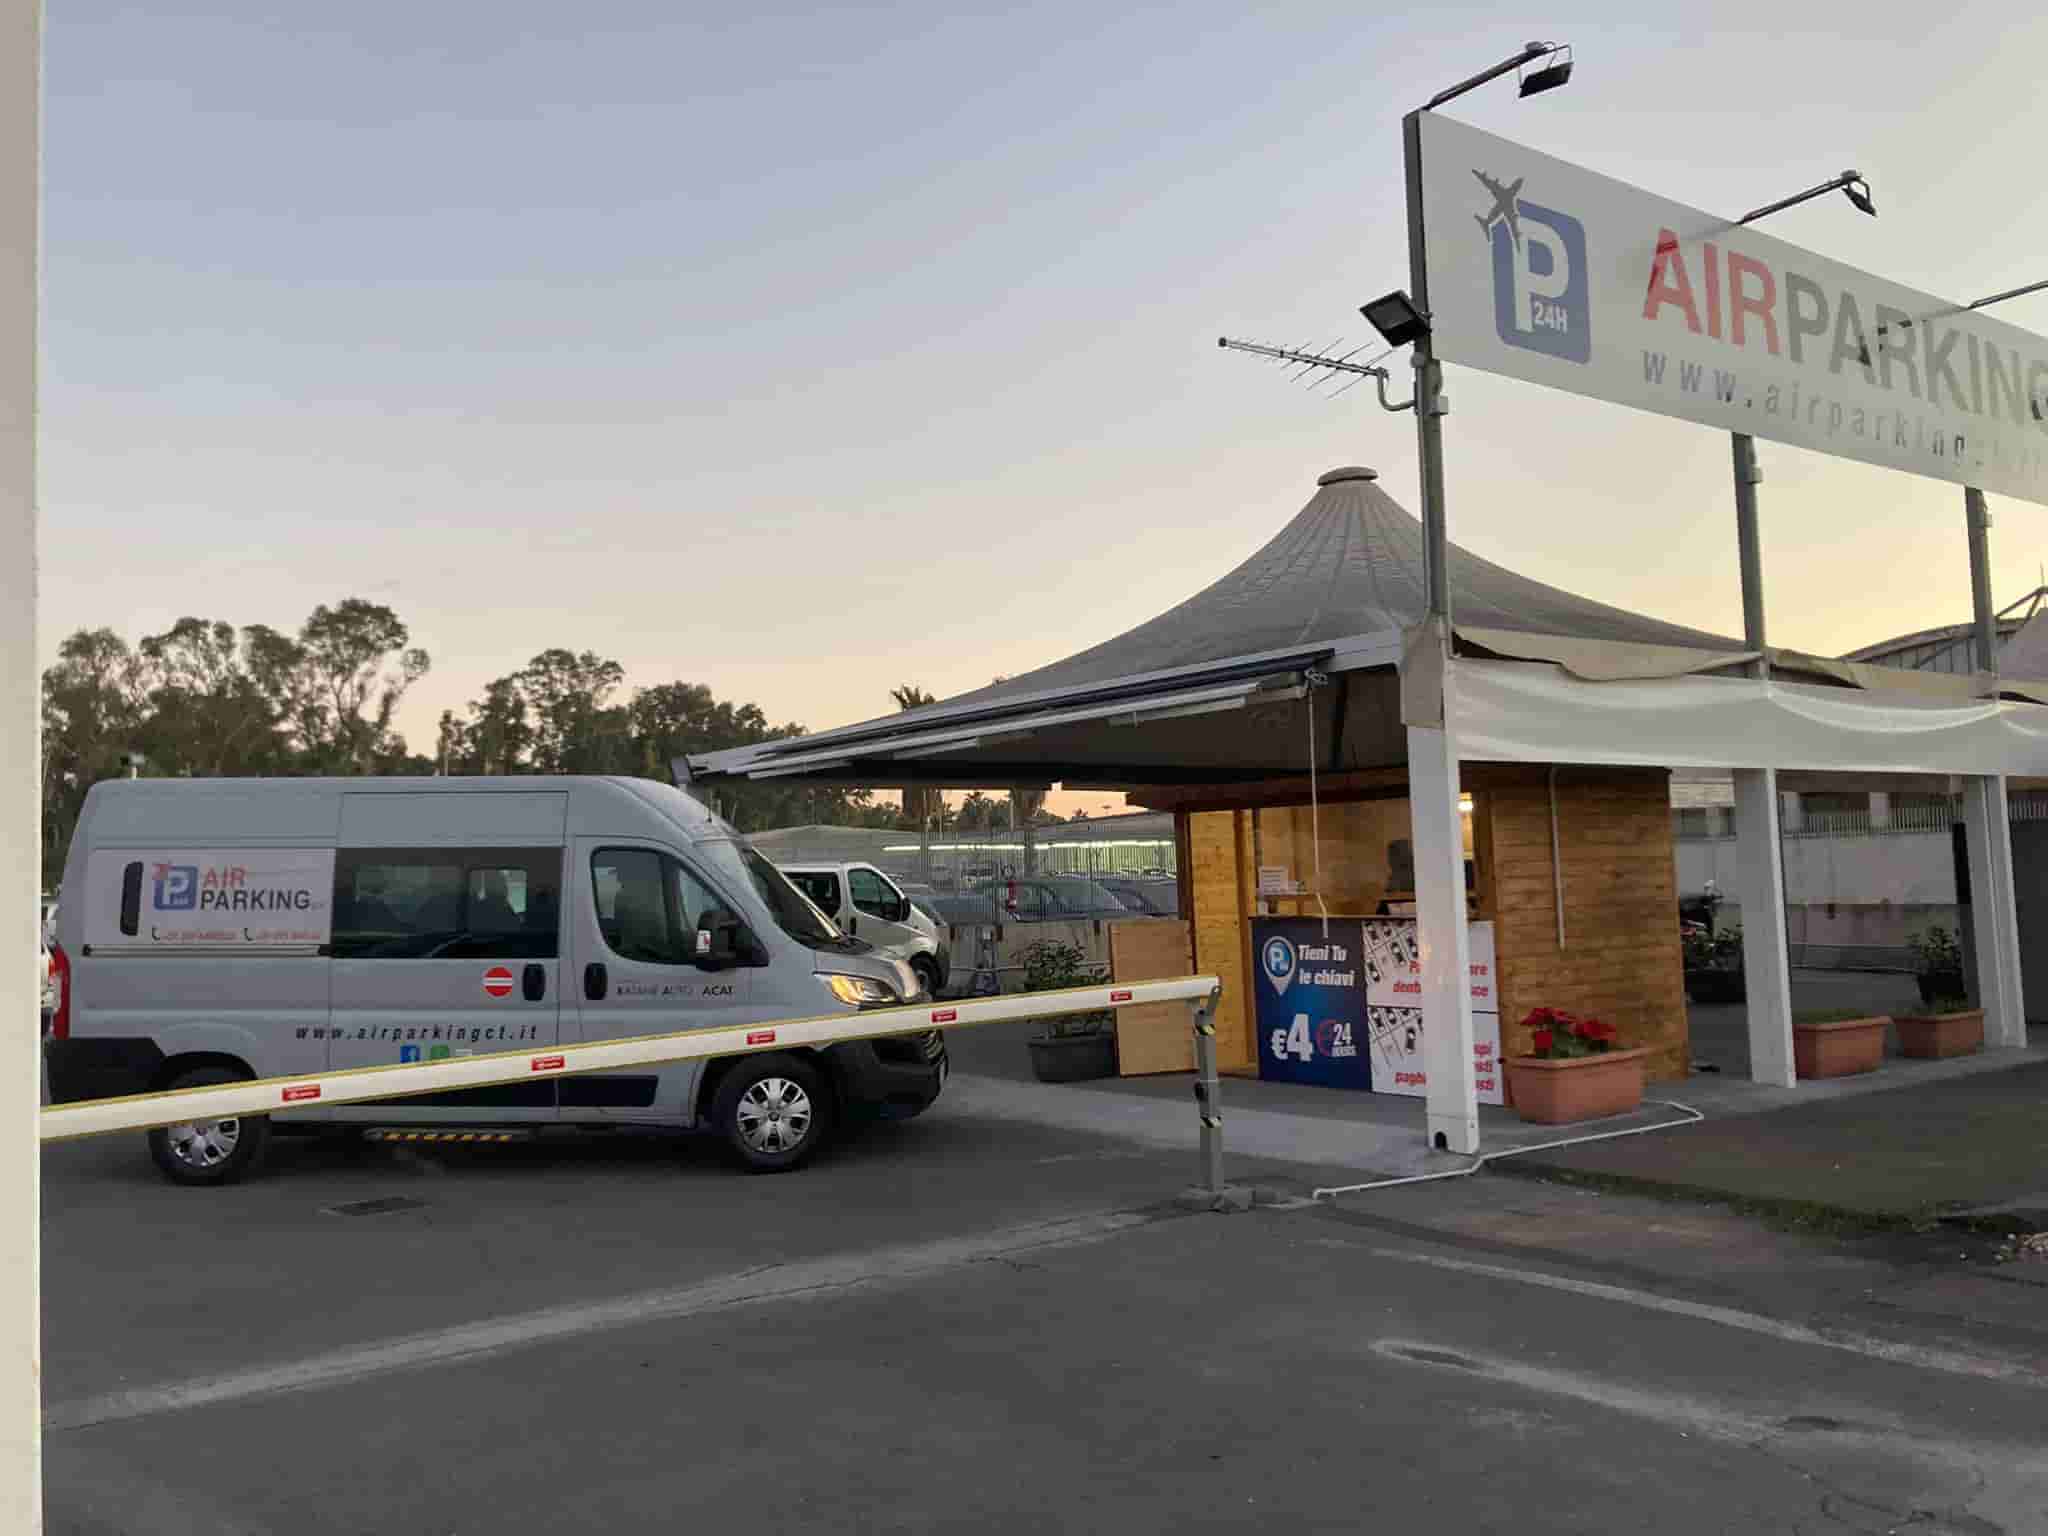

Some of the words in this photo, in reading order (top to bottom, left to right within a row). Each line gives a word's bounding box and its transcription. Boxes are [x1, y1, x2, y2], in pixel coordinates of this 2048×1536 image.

[1534, 301, 1568, 334] 24H
[202, 865, 247, 889] AIR
[200, 889, 312, 911] PARKING
[295, 1023, 538, 1042] www.airparkingct.it
[1333, 1023, 1353, 1046] 24
